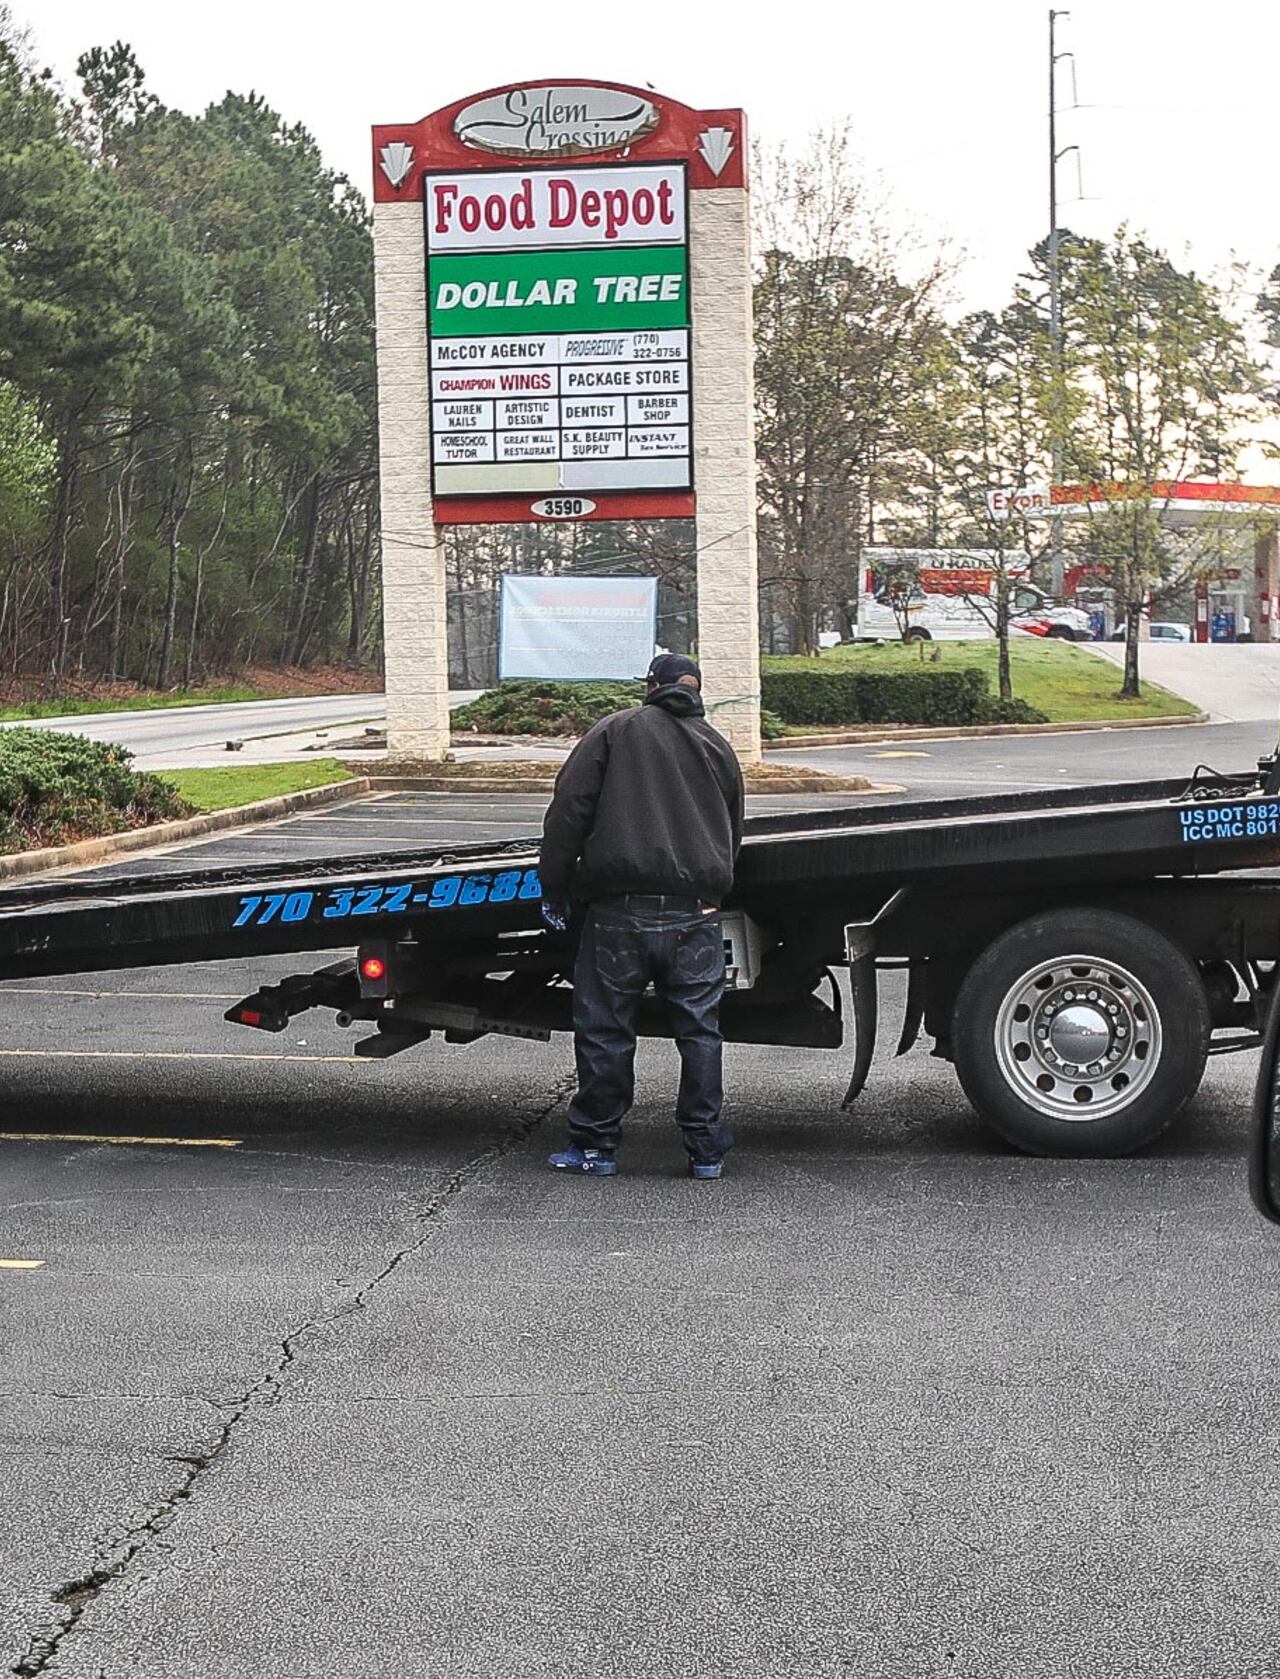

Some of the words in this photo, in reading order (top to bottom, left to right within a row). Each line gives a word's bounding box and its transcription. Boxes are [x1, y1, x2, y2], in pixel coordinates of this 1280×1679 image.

[505, 90, 588, 128] Salem
[434, 179, 535, 234] Food
[548, 178, 675, 239] Depot
[436, 278, 578, 310] DOLLAR
[594, 274, 682, 304] TREE
[633, 333, 660, 346] (770)
[437, 344, 487, 360] McCOY
[491, 342, 546, 359] AGENCY
[565, 339, 625, 357] PROGRESSIVE
[633, 347, 682, 359] 322-0756
[439, 379, 496, 391] CHAMPION
[500, 373, 552, 390] WINGS
[568, 371, 631, 387] PACKAGE
[635, 370, 680, 384] STORE
[443, 404, 482, 415] LAUREN
[505, 402, 550, 414] ARTISTIC
[638, 398, 678, 409] BARBER
[565, 405, 616, 418] DENTIST
[643, 411, 671, 421] SHOP
[448, 417, 477, 427] NAILS
[508, 415, 544, 426] DESIGN
[440, 435, 489, 447] HOMESCHOOL
[504, 435, 529, 444] GREAT
[532, 435, 554, 443] WALL
[585, 431, 624, 443] BEAUTY
[629, 433, 677, 443] INSTANT
[446, 449, 478, 458] TUTOR
[504, 446, 556, 456] RESTAURANT
[572, 444, 610, 456] SUPPLY
[544, 499, 582, 516] 3590
[1183, 824, 1213, 841] ICC
[1216, 823, 1244, 839] MC
[232, 892, 314, 927] 770
